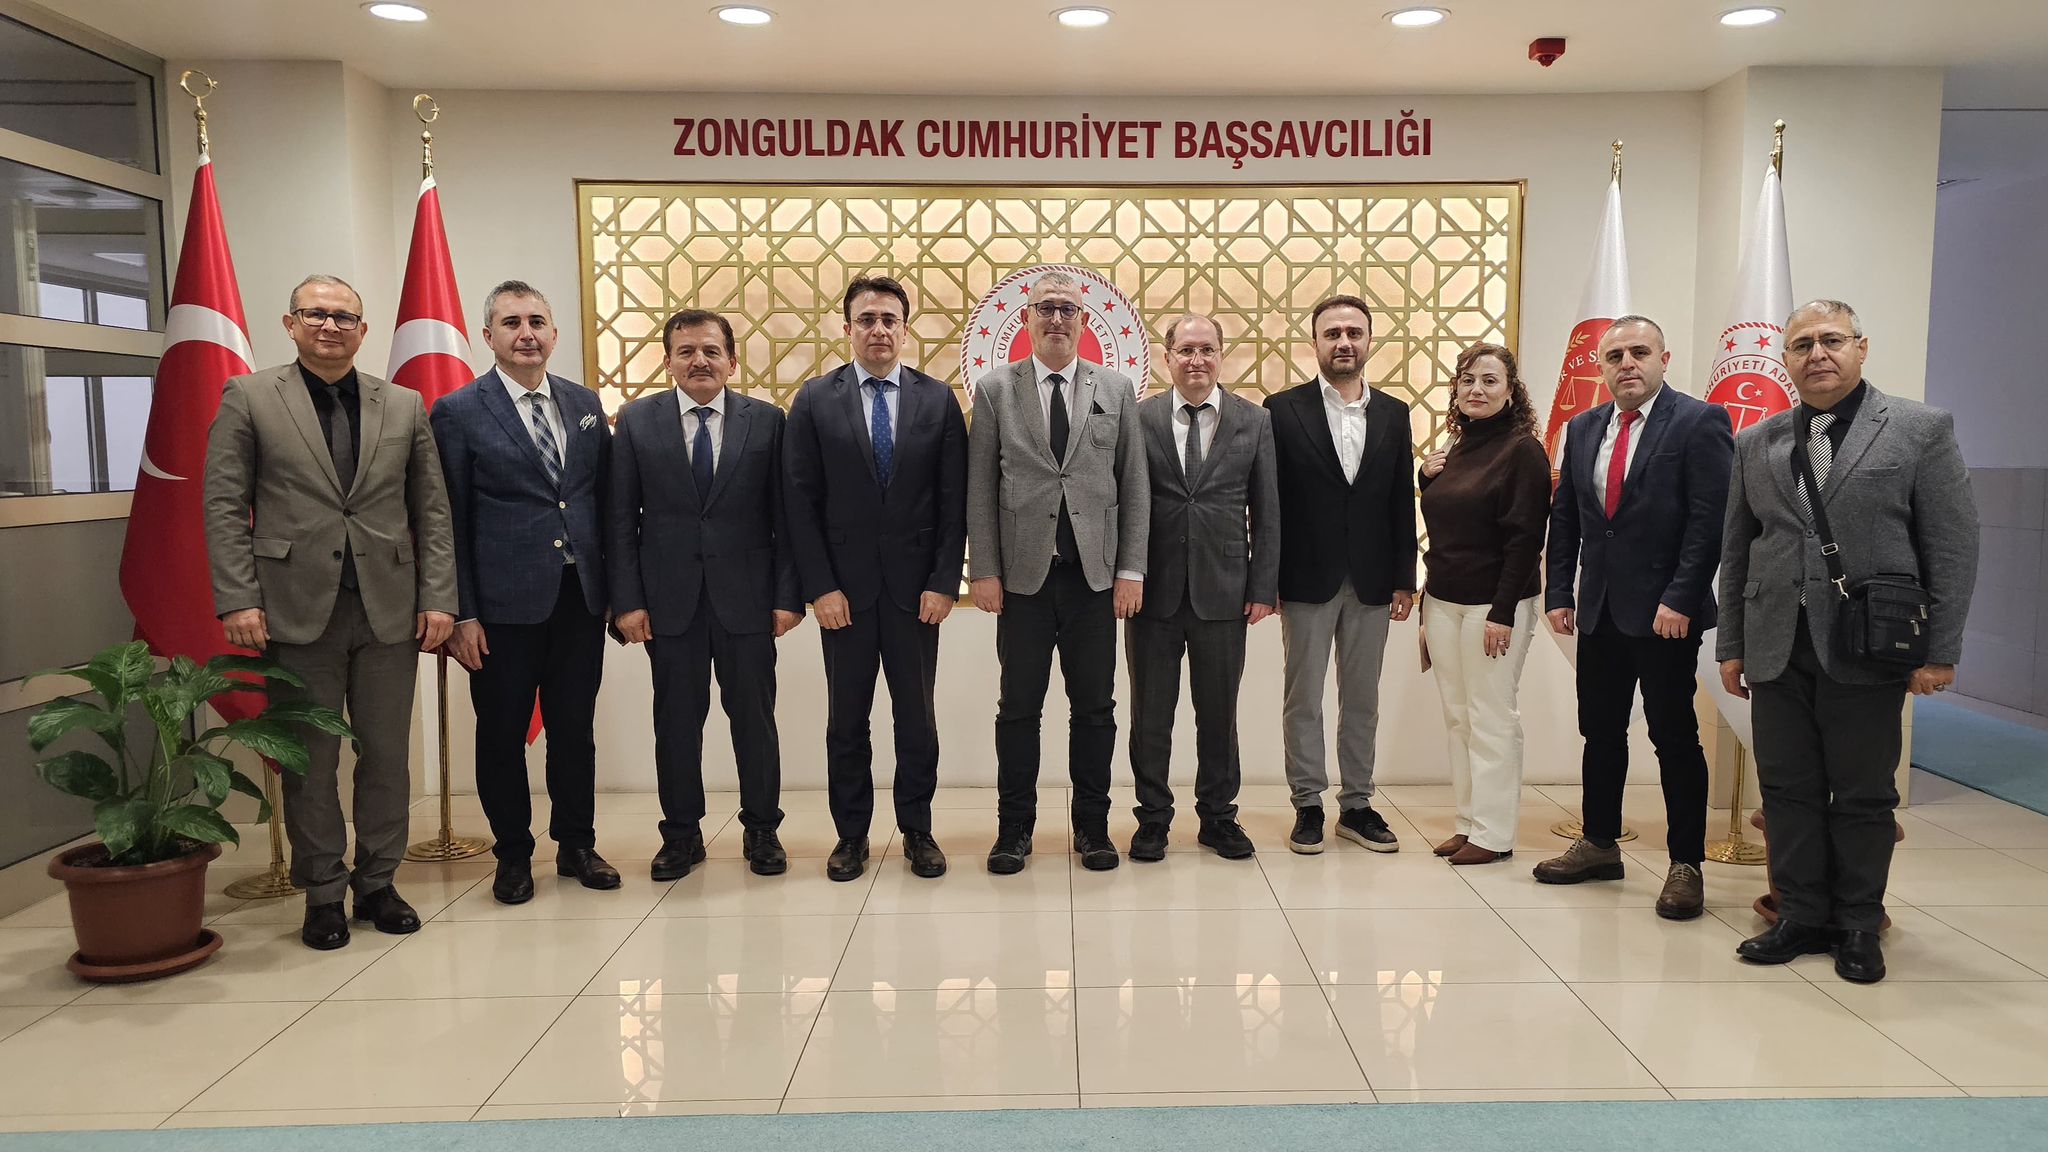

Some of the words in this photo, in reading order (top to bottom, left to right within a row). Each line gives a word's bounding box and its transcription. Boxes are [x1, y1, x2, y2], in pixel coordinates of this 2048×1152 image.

[673, 117, 905, 157] ZONGULDAK
[916, 112, 1162, 159] CUMHURİYET
[1174, 109, 1433, 169] BAŞSAVCILIĞI
[996, 315, 1022, 360] CUMHU
[1089, 317, 1109, 338] LET
[1103, 342, 1115, 369] BAK
[1568, 354, 1585, 370] VE
[1768, 367, 1800, 407] ADALE
